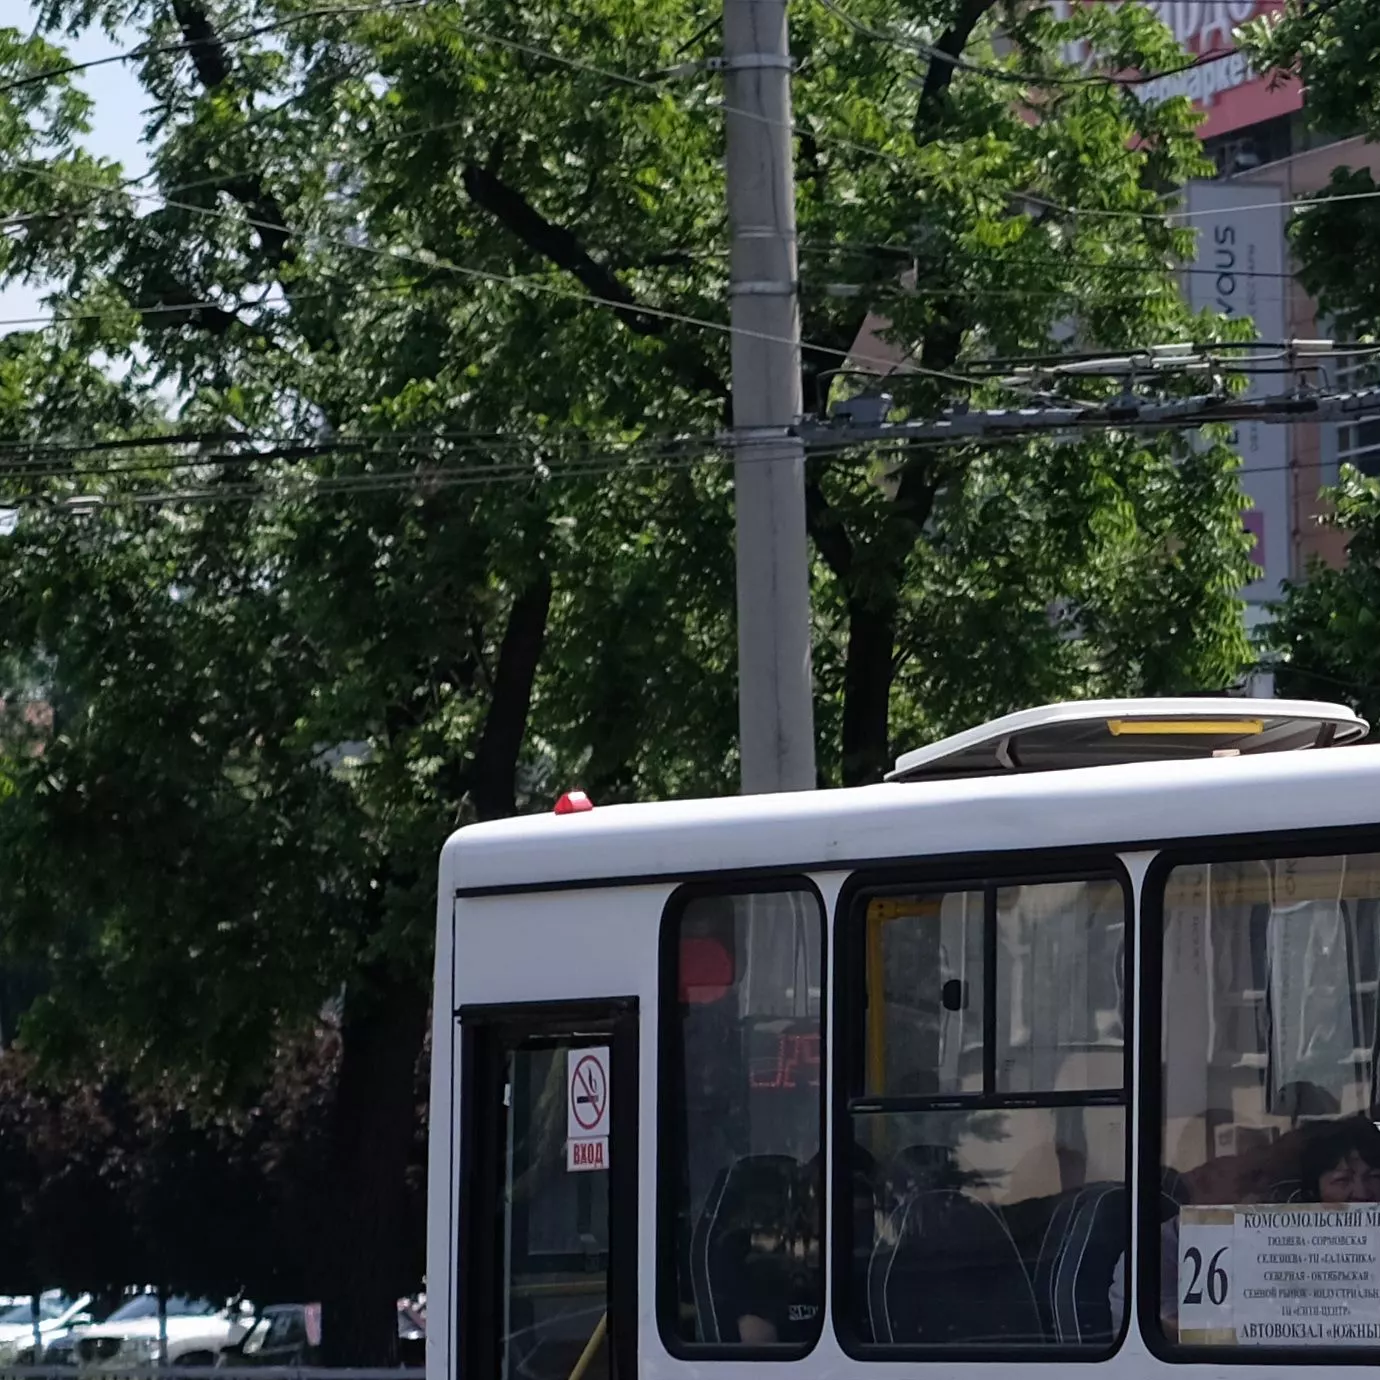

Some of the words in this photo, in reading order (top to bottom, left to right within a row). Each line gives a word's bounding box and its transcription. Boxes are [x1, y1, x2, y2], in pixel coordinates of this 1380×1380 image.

[573, 1143, 604, 1168] ВХОД
[1243, 1211, 1362, 1229] КОМСОМОЛЬСКИЙ
[1182, 1246, 1229, 1306] 26
[1240, 1322, 1322, 1338] АВТОВОКЗАЛ
